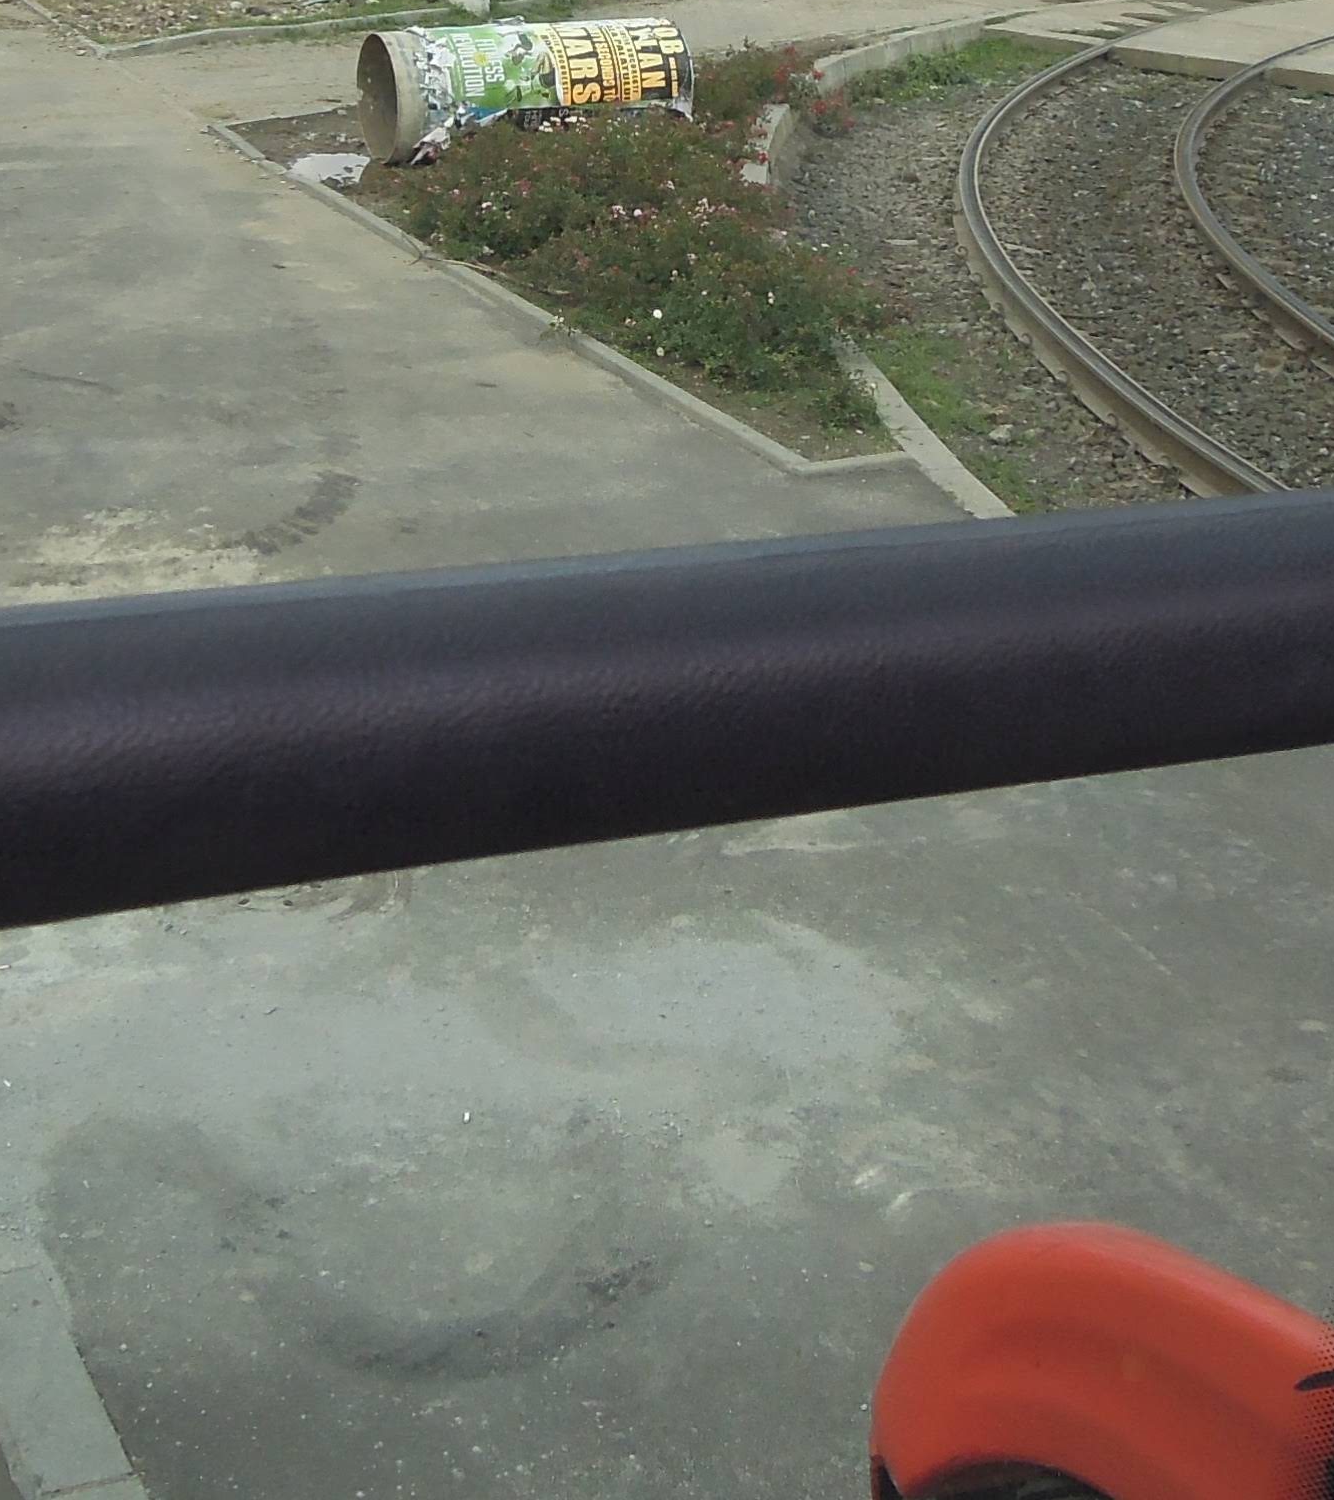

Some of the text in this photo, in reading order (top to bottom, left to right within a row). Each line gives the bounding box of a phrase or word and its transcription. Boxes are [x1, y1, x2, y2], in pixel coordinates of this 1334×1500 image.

[452, 33, 486, 98] REVOLUTION
[553, 25, 602, 105] MARS
[628, 27, 666, 89] YLAN
